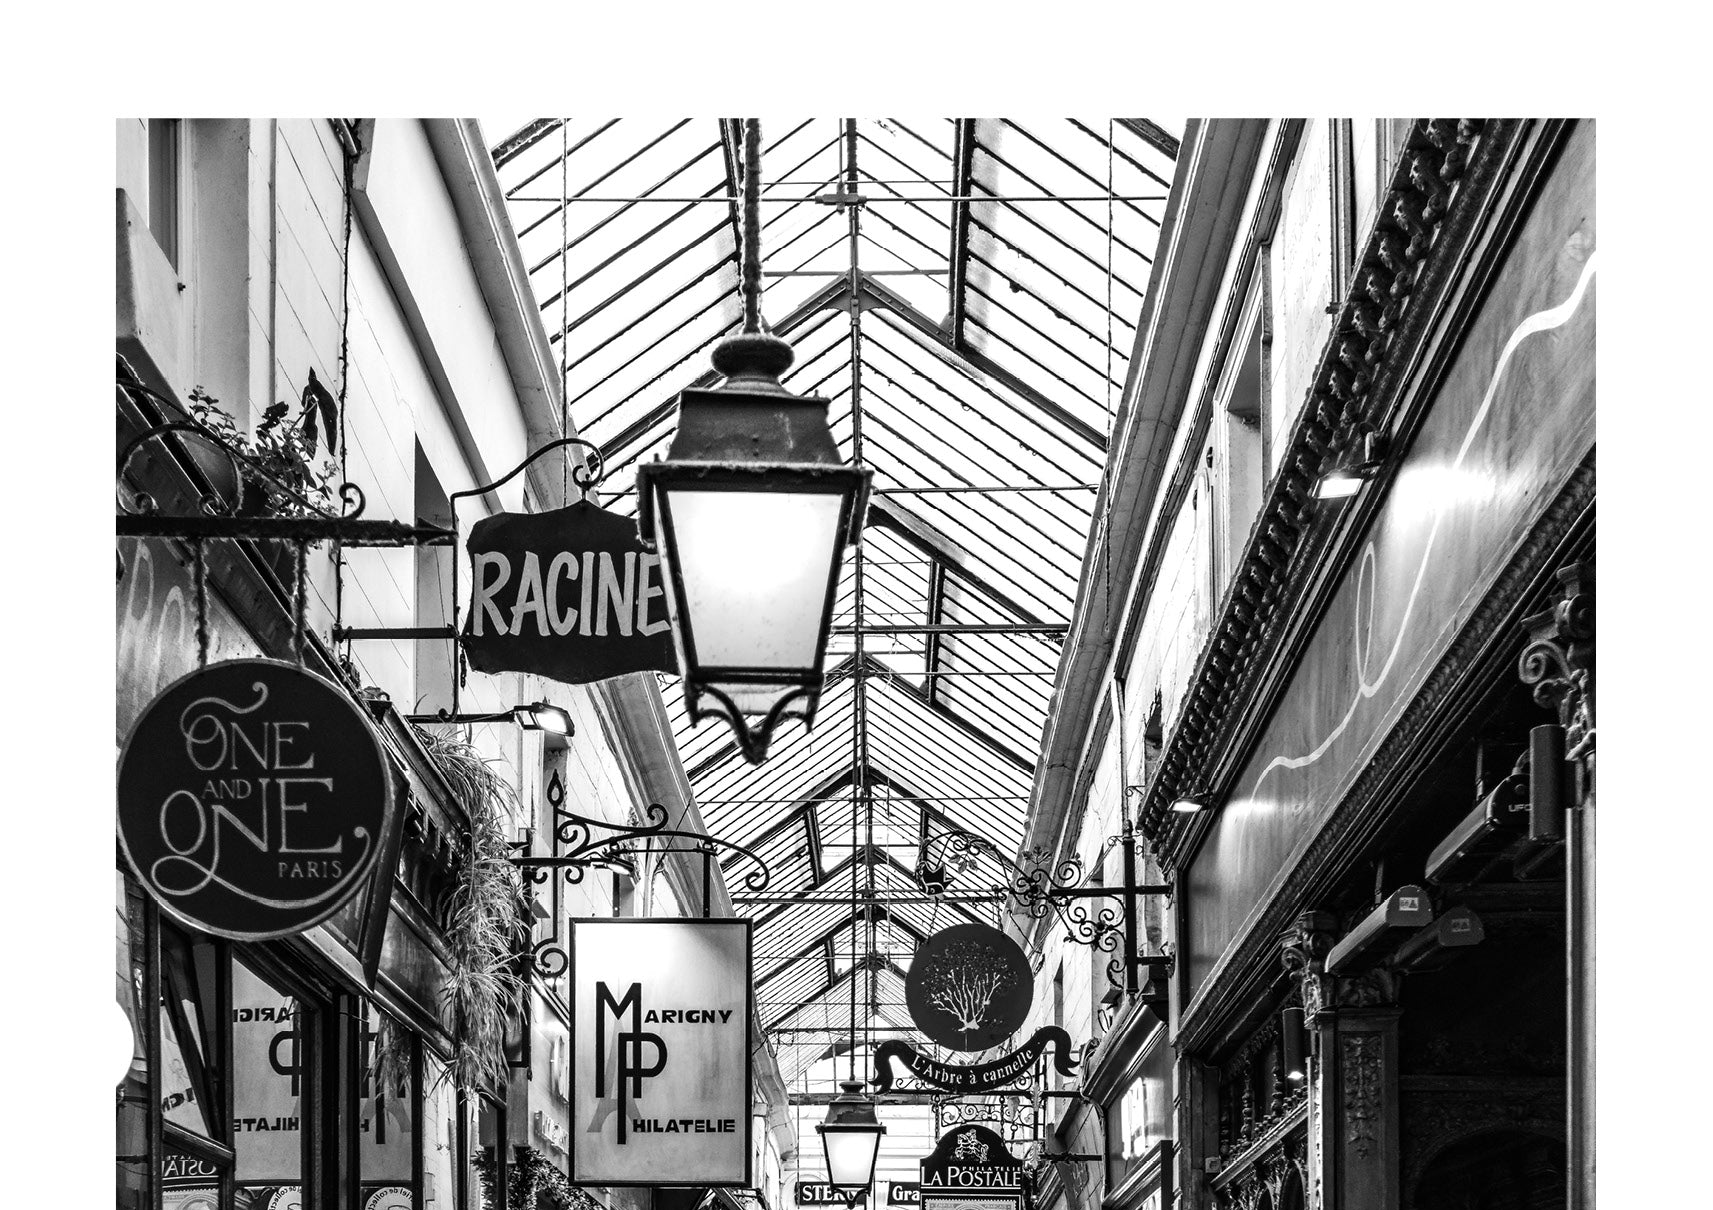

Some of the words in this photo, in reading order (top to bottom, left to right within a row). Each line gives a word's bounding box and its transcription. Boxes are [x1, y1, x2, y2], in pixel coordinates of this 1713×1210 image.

[473, 550, 671, 637] RACINE
[181, 696, 315, 771] ONE
[202, 779, 251, 800] AND
[156, 777, 347, 876] ONE
[277, 861, 342, 878] PARIS
[911, 1054, 963, 1085] L'Arbre
[969, 1069, 977, 1085] à
[983, 1049, 1034, 1083] cannelle
[921, 1166, 943, 1186] LA
[947, 1166, 1021, 1187] POSTALE
[892, 1185, 920, 1201] Gra
